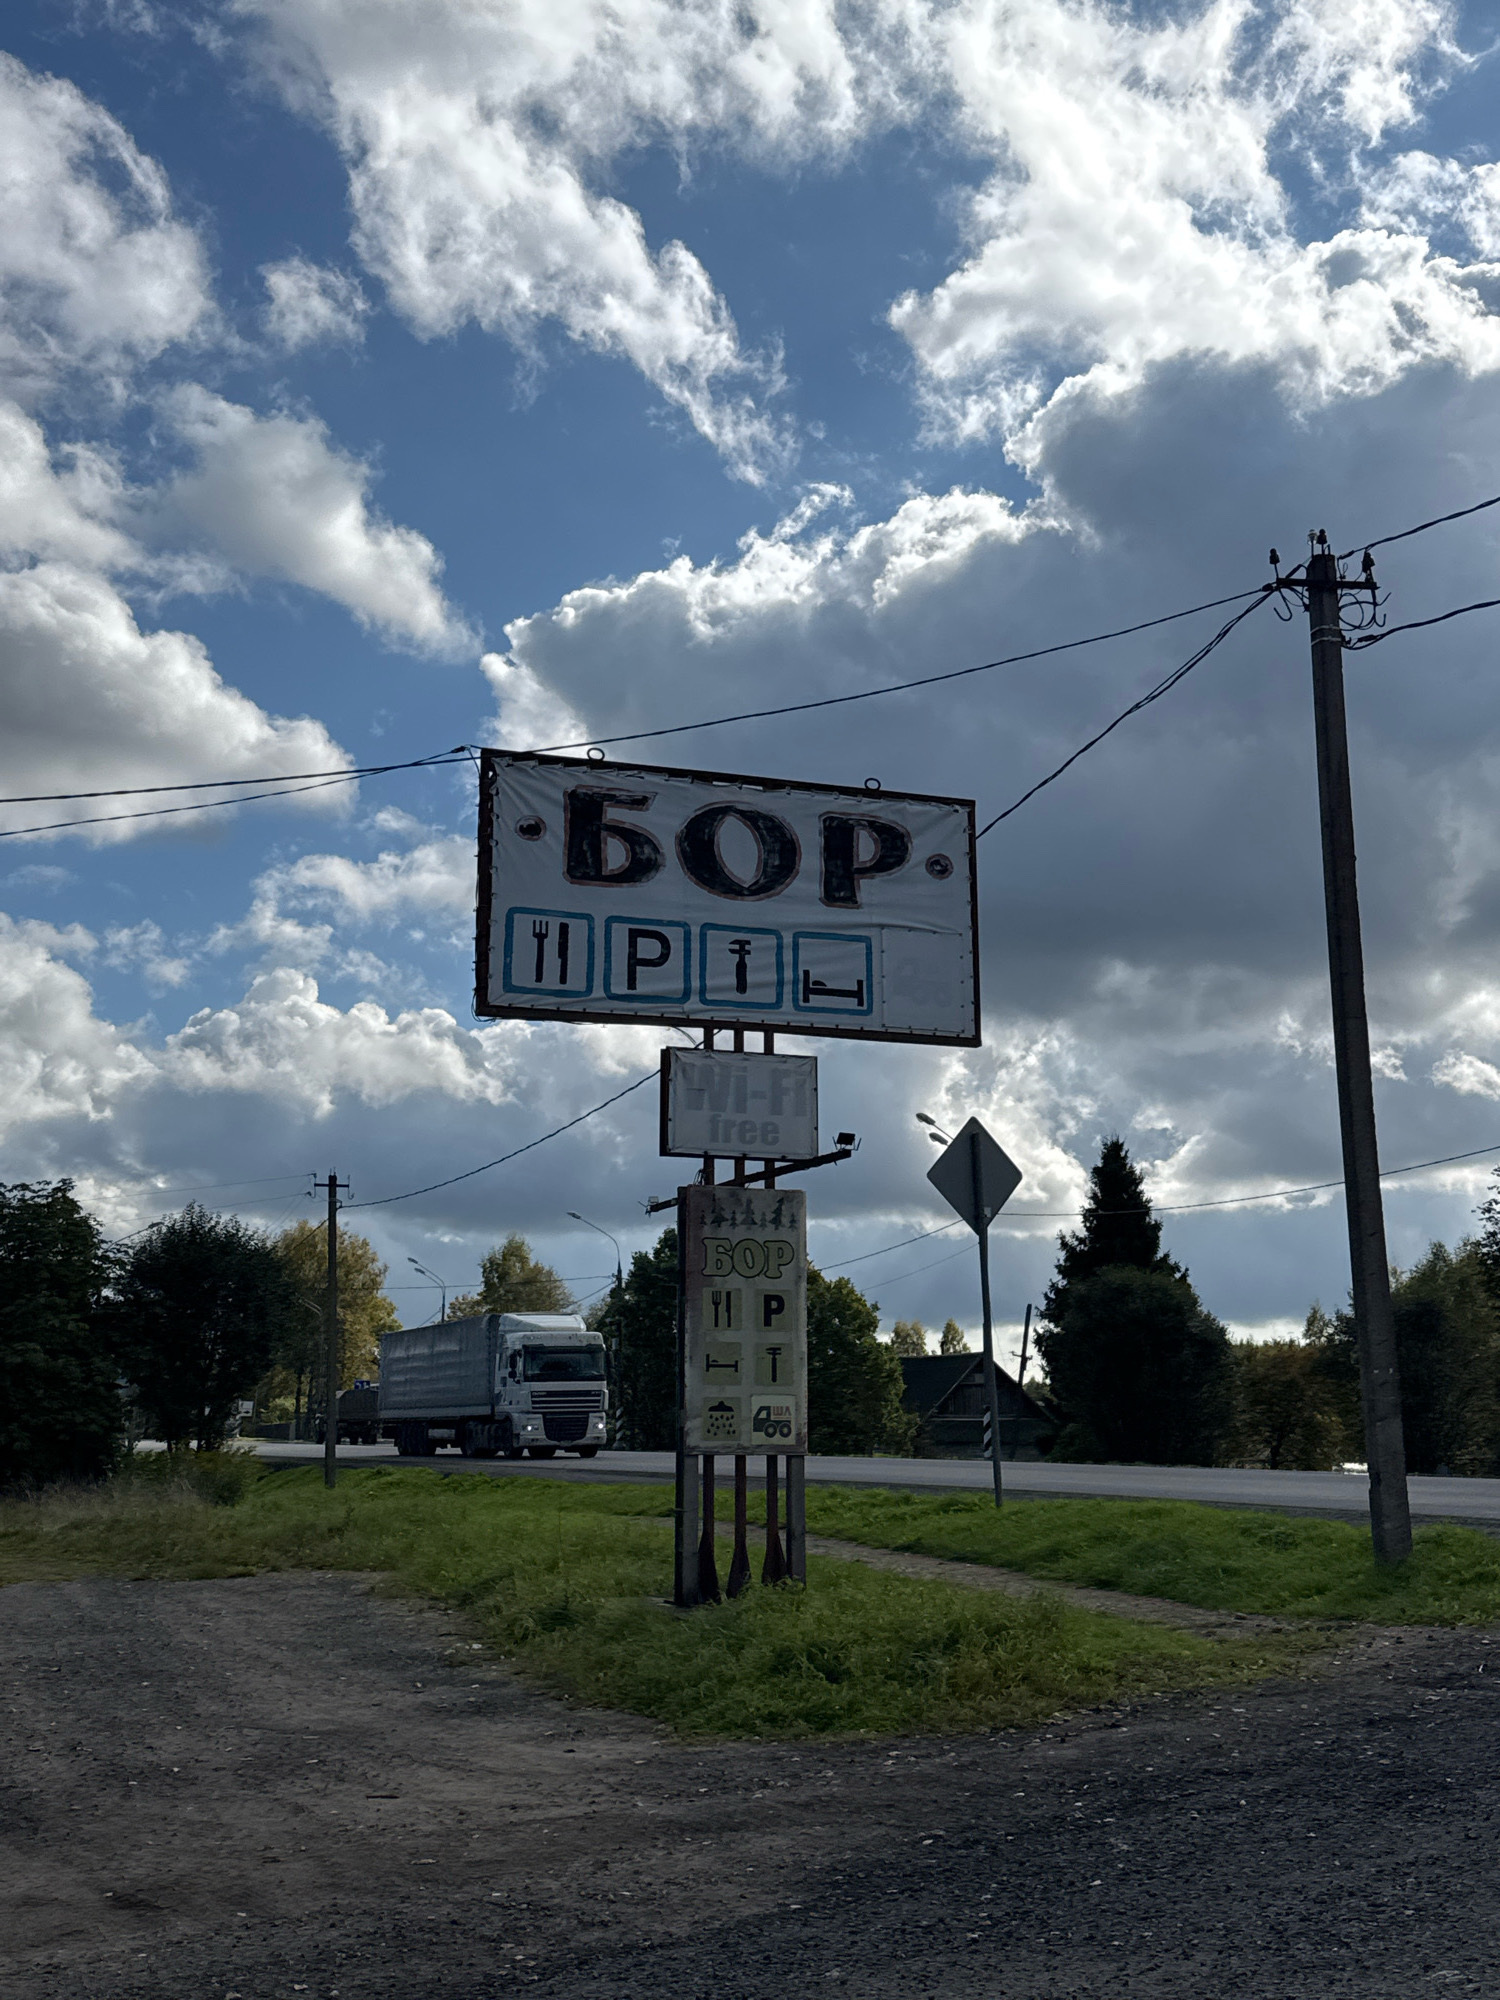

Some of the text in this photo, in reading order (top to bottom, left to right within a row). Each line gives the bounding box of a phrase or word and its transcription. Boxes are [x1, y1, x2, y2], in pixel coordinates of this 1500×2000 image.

[563, 784, 913, 909] БОР
[681, 1062, 808, 1117] Wi-Fi
[709, 1114, 780, 1146] free
[701, 1237, 795, 1279] БОР
